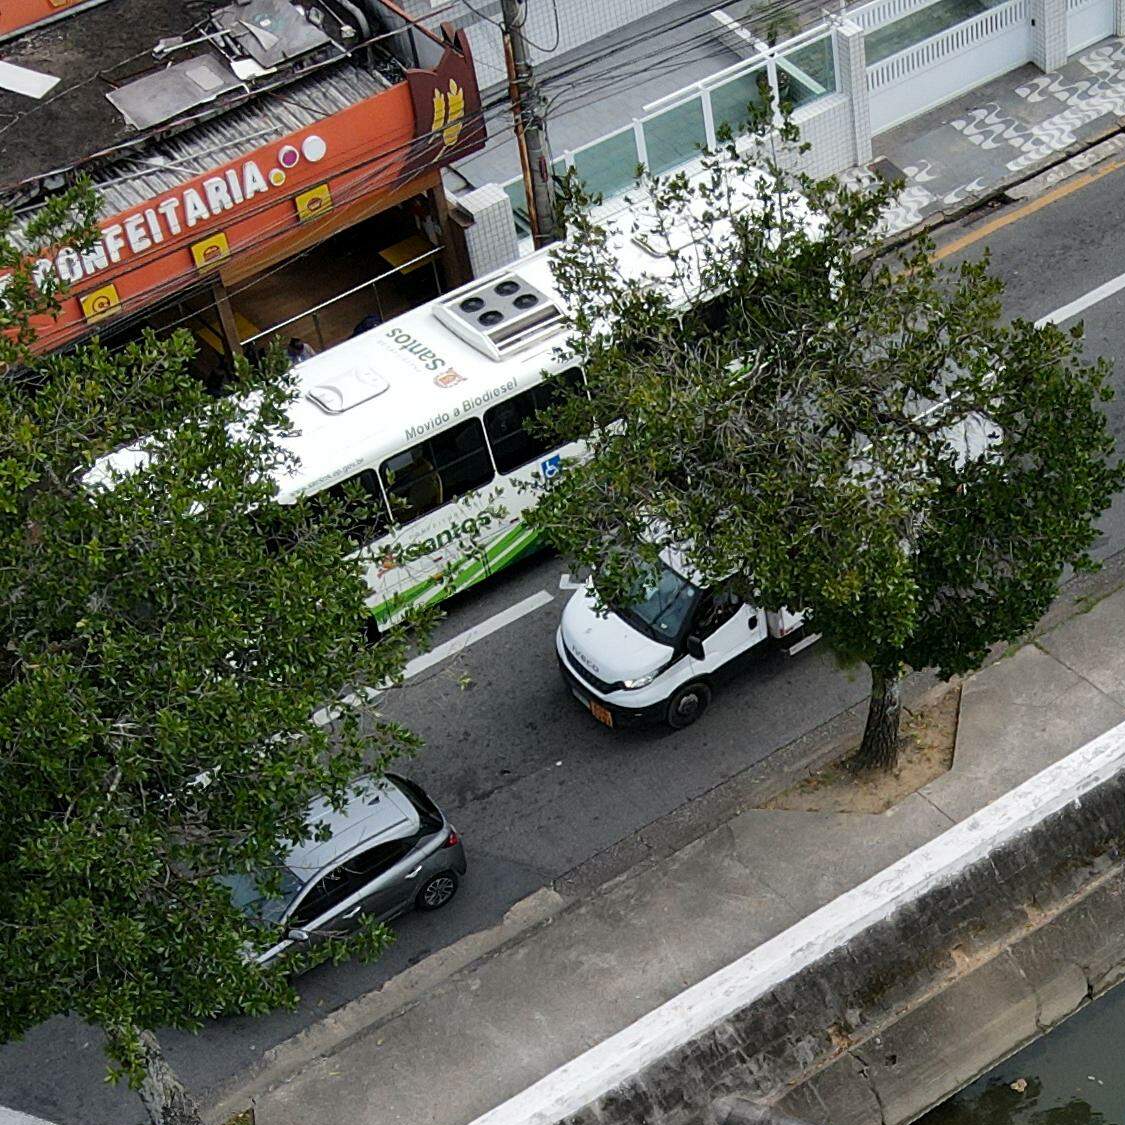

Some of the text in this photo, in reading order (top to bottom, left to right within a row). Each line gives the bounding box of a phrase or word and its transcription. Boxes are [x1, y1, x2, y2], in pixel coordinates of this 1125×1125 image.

[32, 160, 269, 295] CONFEITARIA
[386, 327, 446, 371] Santos
[404, 376, 518, 441] Movido a Biodiesel
